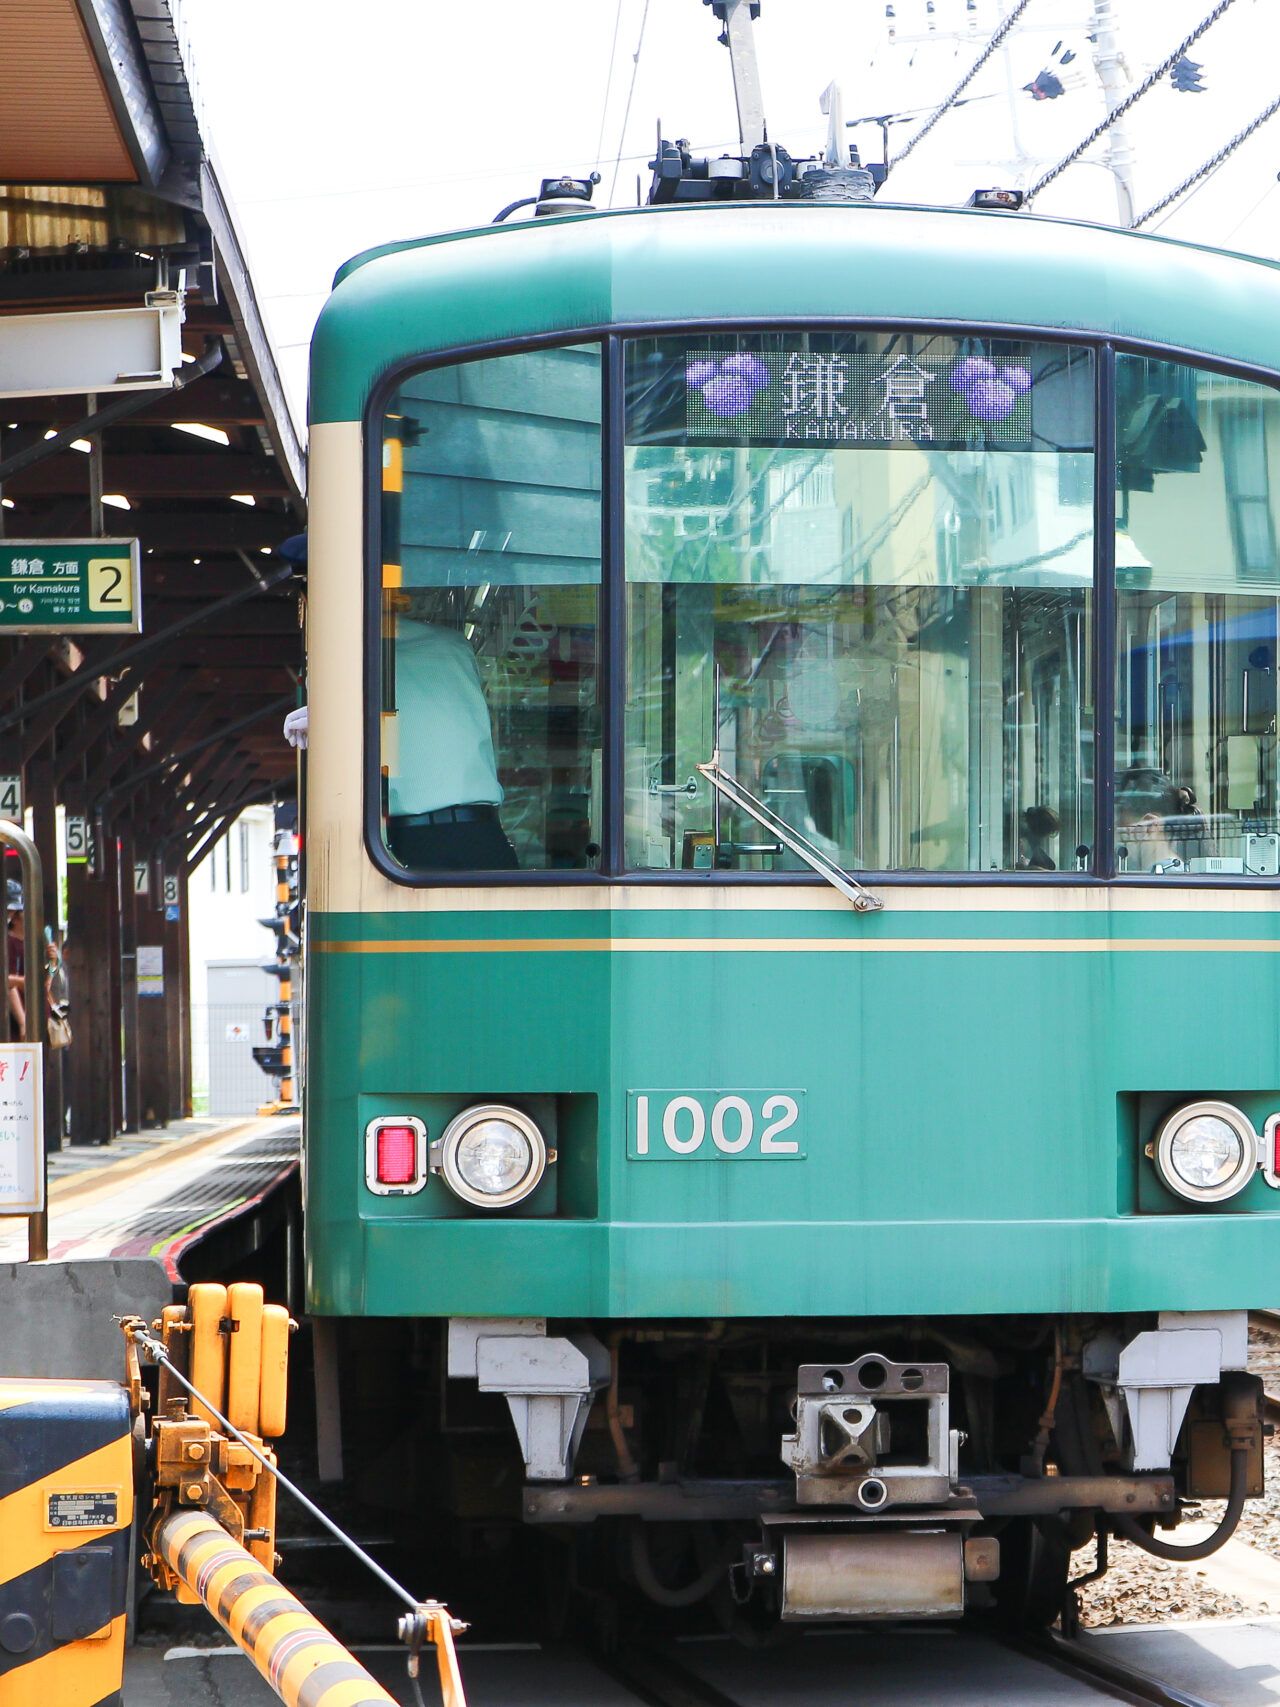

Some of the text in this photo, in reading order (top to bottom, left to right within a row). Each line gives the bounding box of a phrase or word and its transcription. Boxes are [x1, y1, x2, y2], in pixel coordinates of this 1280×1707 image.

[780, 351, 937, 420] 鎌倉
[785, 418, 935, 442] KAMAKURA
[11, 558, 79, 576] 鎌倉 方面
[13, 583, 80, 594] for Kamakura
[99, 566, 122, 603] 2
[1, 784, 19, 816] 4
[68, 824, 83, 850] 5
[134, 868, 146, 890] 7
[164, 882, 176, 900] 8
[636, 1094, 799, 1155] 1002
